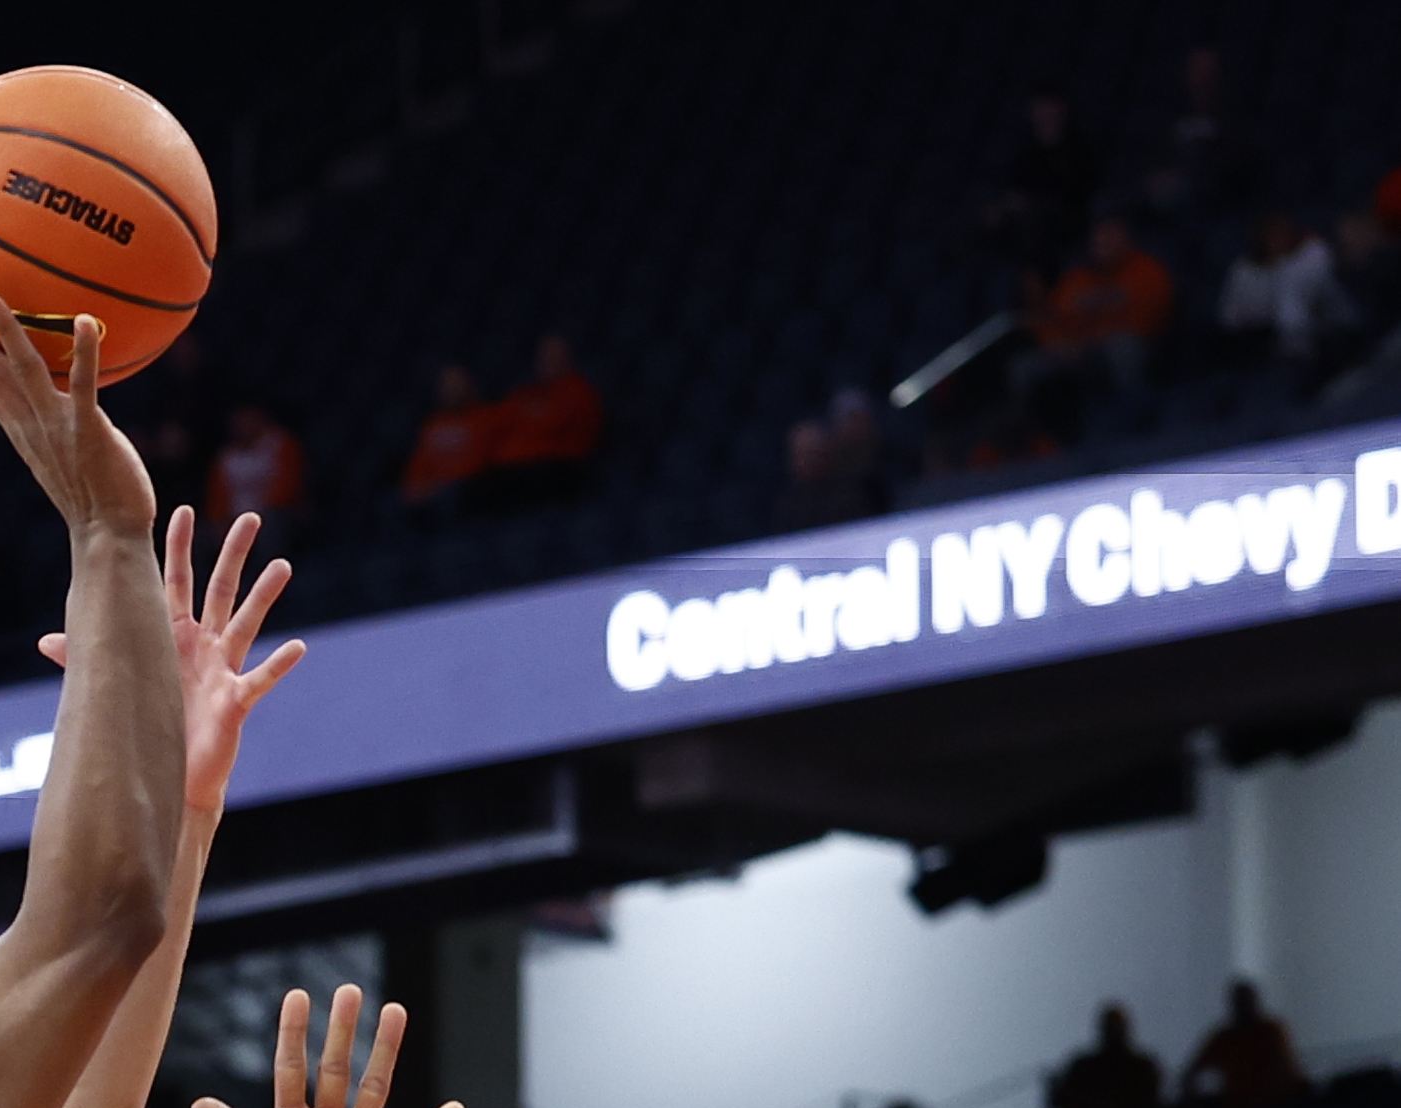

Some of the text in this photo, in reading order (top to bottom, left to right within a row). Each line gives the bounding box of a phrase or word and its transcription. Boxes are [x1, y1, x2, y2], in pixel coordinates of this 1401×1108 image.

[2, 169, 135, 246] SYRACUSE
[606, 536, 920, 692] Central
[931, 513, 1065, 634] NY
[1066, 478, 1346, 605] Chevy
